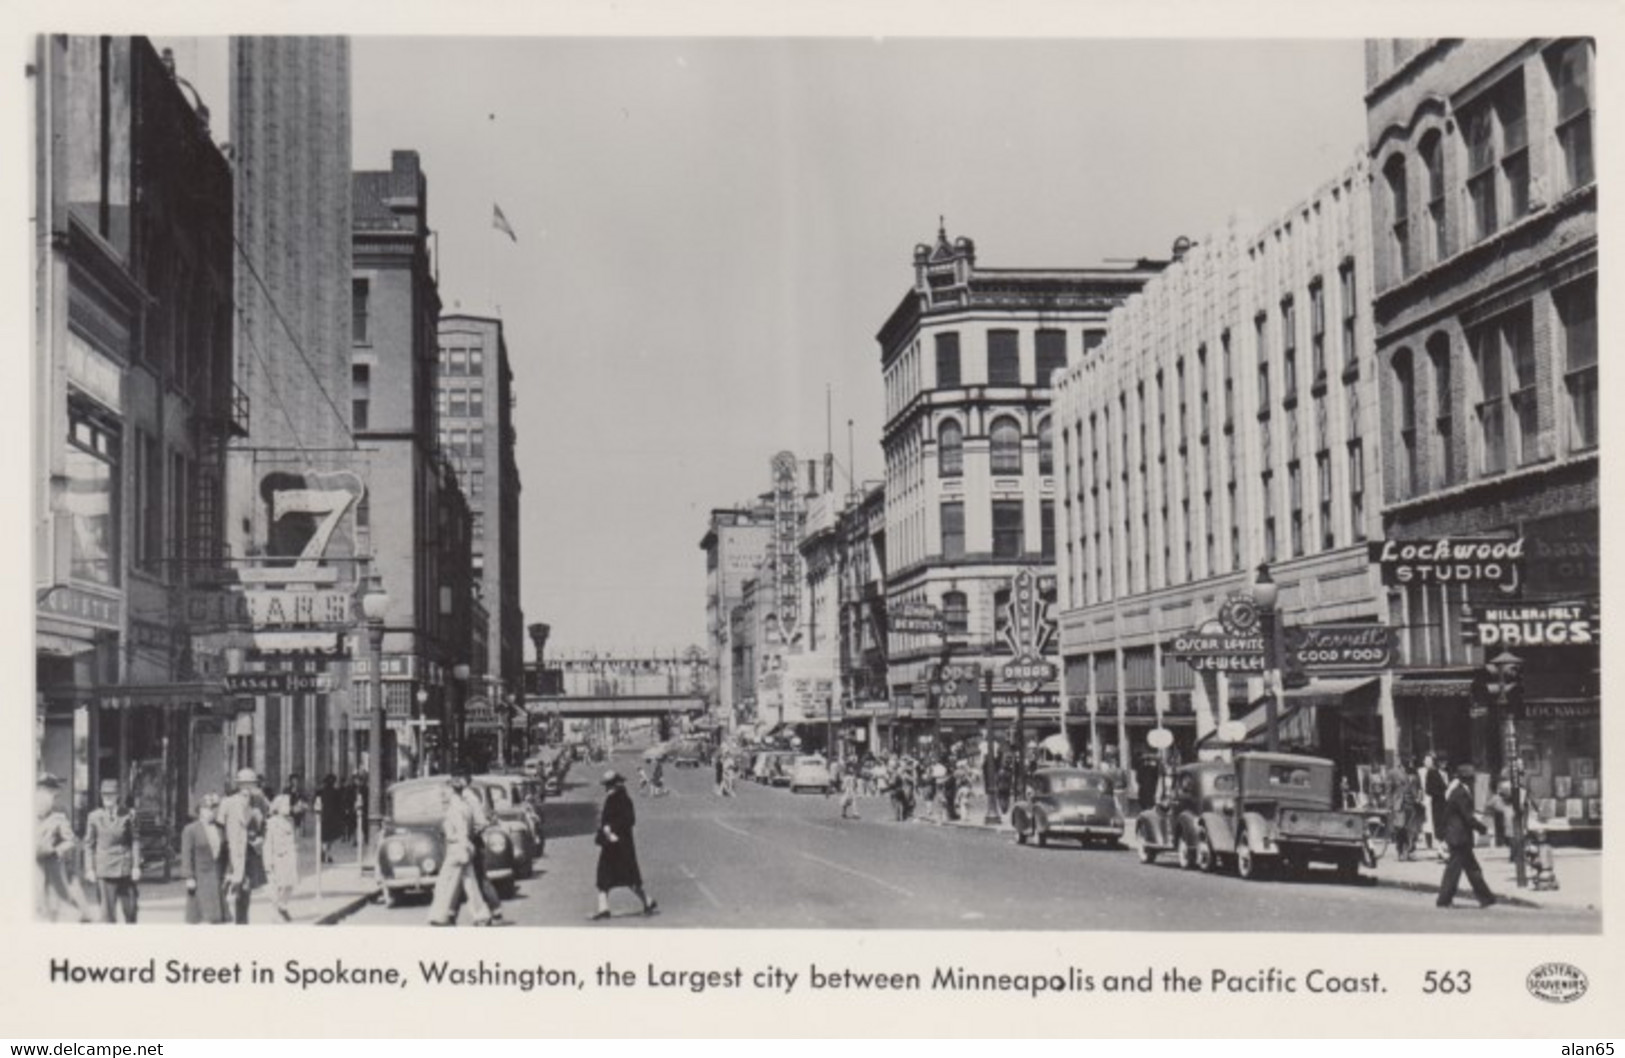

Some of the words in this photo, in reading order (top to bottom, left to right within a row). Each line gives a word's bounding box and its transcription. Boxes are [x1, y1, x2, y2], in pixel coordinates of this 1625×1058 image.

[1380, 539, 1524, 562] Lockwood
[1397, 563, 1501, 582] STUDIO
[1478, 622, 1591, 645] DRUGS
[1343, 649, 1382, 660] FOOD
[1004, 665, 1049, 679] DRUGS
